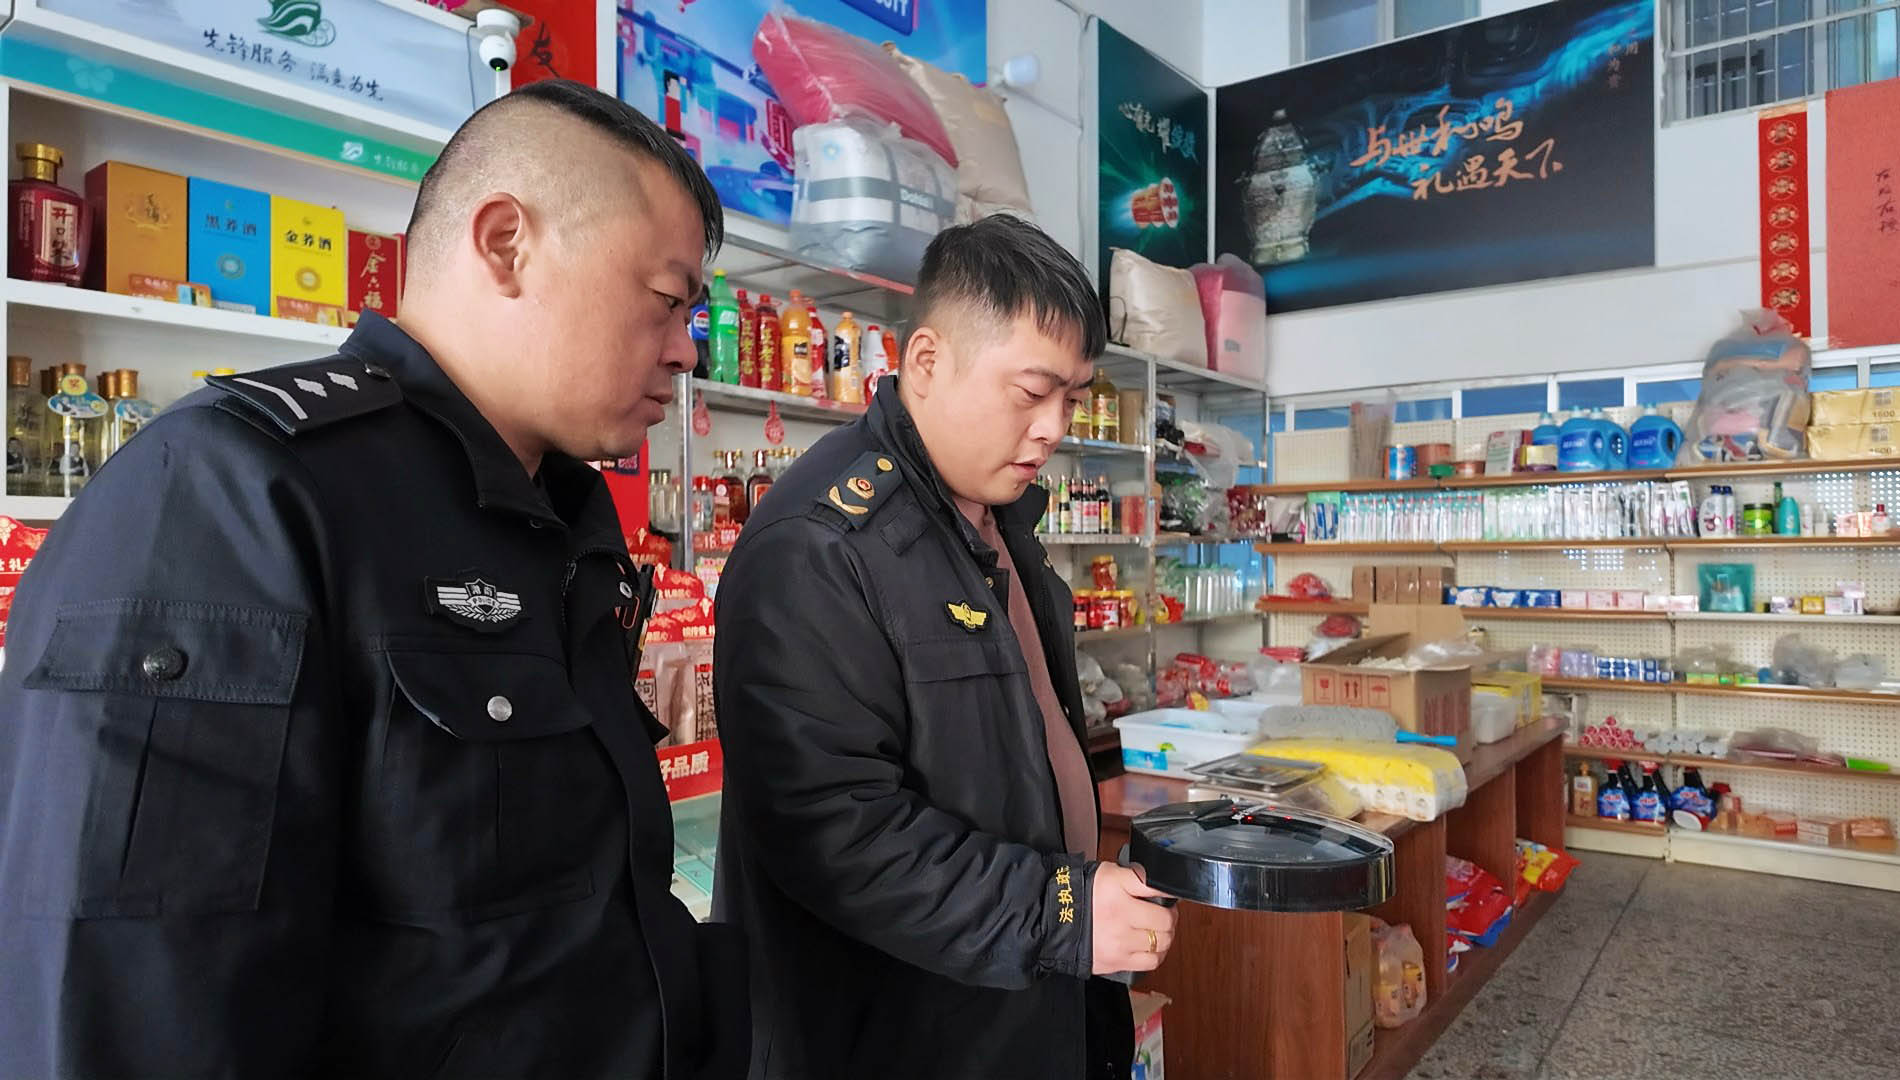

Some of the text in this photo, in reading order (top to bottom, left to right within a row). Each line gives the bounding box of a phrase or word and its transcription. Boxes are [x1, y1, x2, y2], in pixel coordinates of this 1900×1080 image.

[203, 28, 297, 73] 先锋服务
[1350, 97, 1524, 166] 与世和鸣
[1411, 138, 1564, 200] 礼遇天下
[51, 206, 73, 264] 开口笑
[360, 252, 386, 309] 金六福
